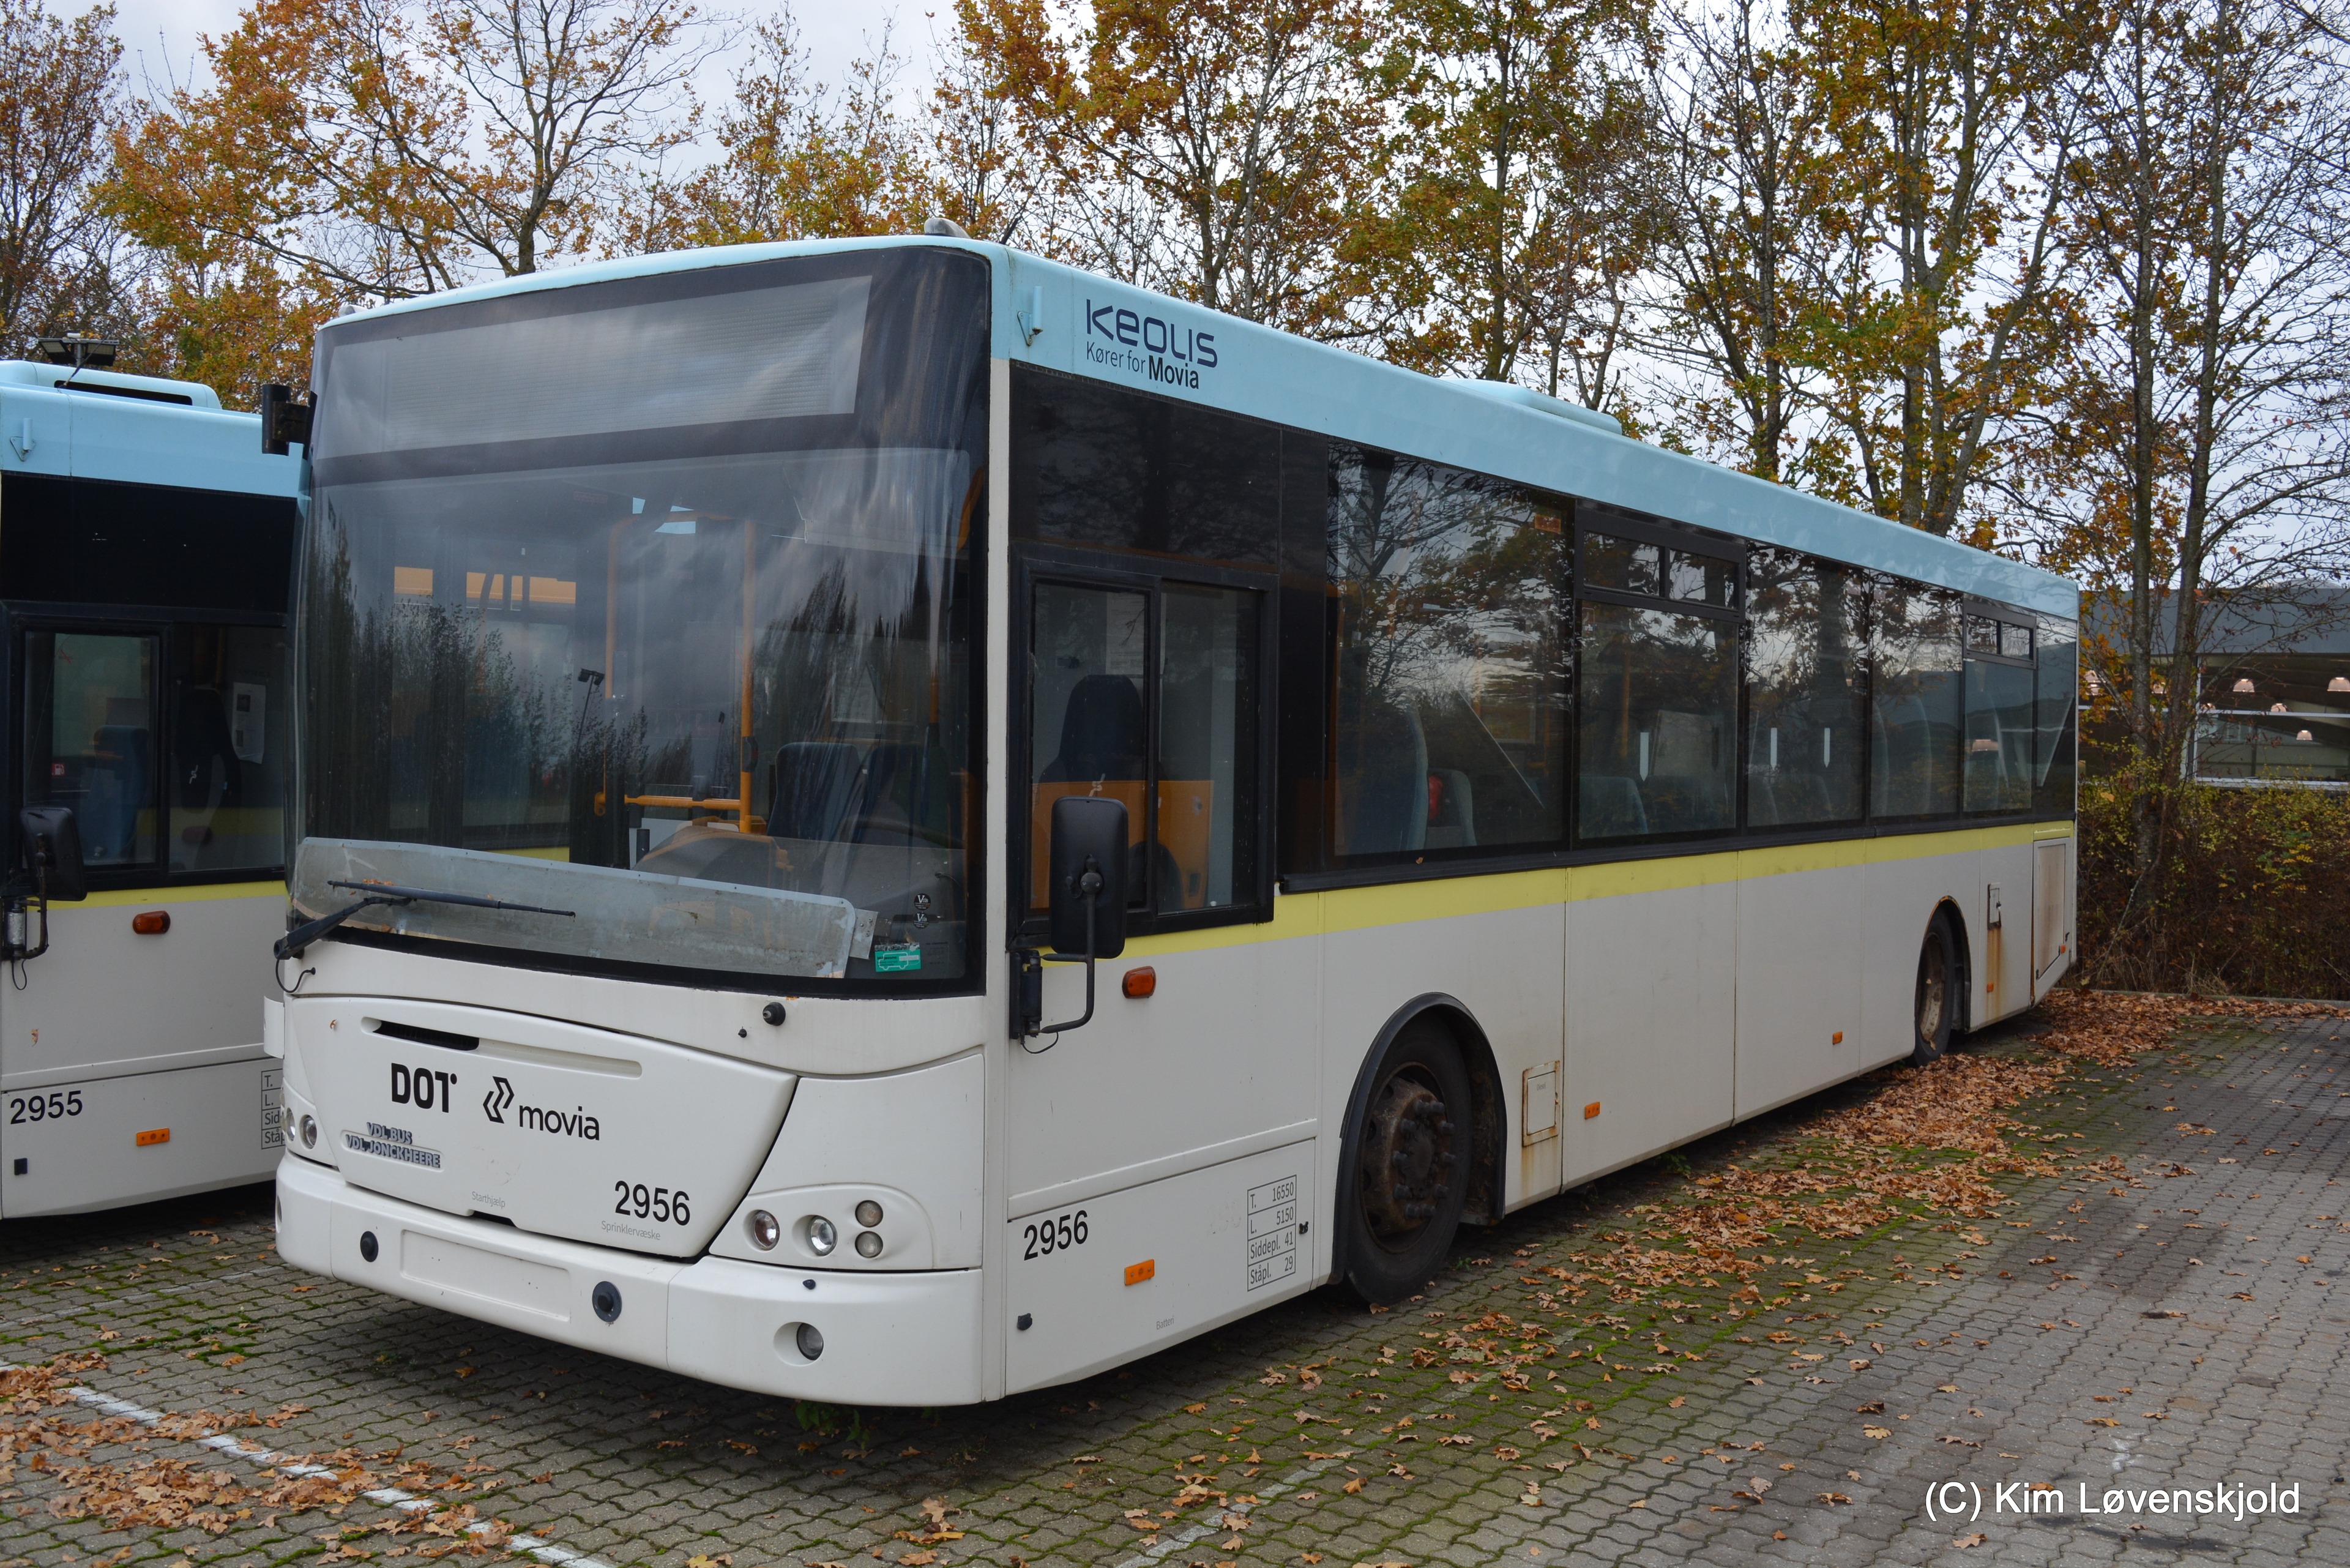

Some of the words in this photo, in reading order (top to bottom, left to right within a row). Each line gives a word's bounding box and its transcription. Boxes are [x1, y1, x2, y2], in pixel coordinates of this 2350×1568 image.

[1087, 341, 1124, 367] Kører
[1127, 350, 1146, 374] for
[1149, 355, 1199, 389] Movia
[10, 1090, 83, 1125] 2955
[518, 1105, 600, 1140] movia
[367, 1122, 389, 1140] VDL
[390, 1127, 412, 1144] BUS
[345, 1134, 367, 1152] VDL
[368, 1140, 441, 1168] JONCKHEERE
[471, 1191, 505, 1209] Starthjælp
[614, 1180, 690, 1226] 2956
[1250, 1193, 1256, 1209] T.
[1272, 1182, 1294, 1202] 16550
[601, 1220, 661, 1241] Sprinklervæske
[1023, 1209, 1089, 1261] 2956
[1250, 1219, 1257, 1234] L.
[1276, 1206, 1294, 1225] 5150
[1250, 1234, 1281, 1260] Siddepl.
[1285, 1231, 1293, 1247] 41
[1250, 1263, 1272, 1285] Ståpl.
[1285, 1255, 1293, 1272] 29
